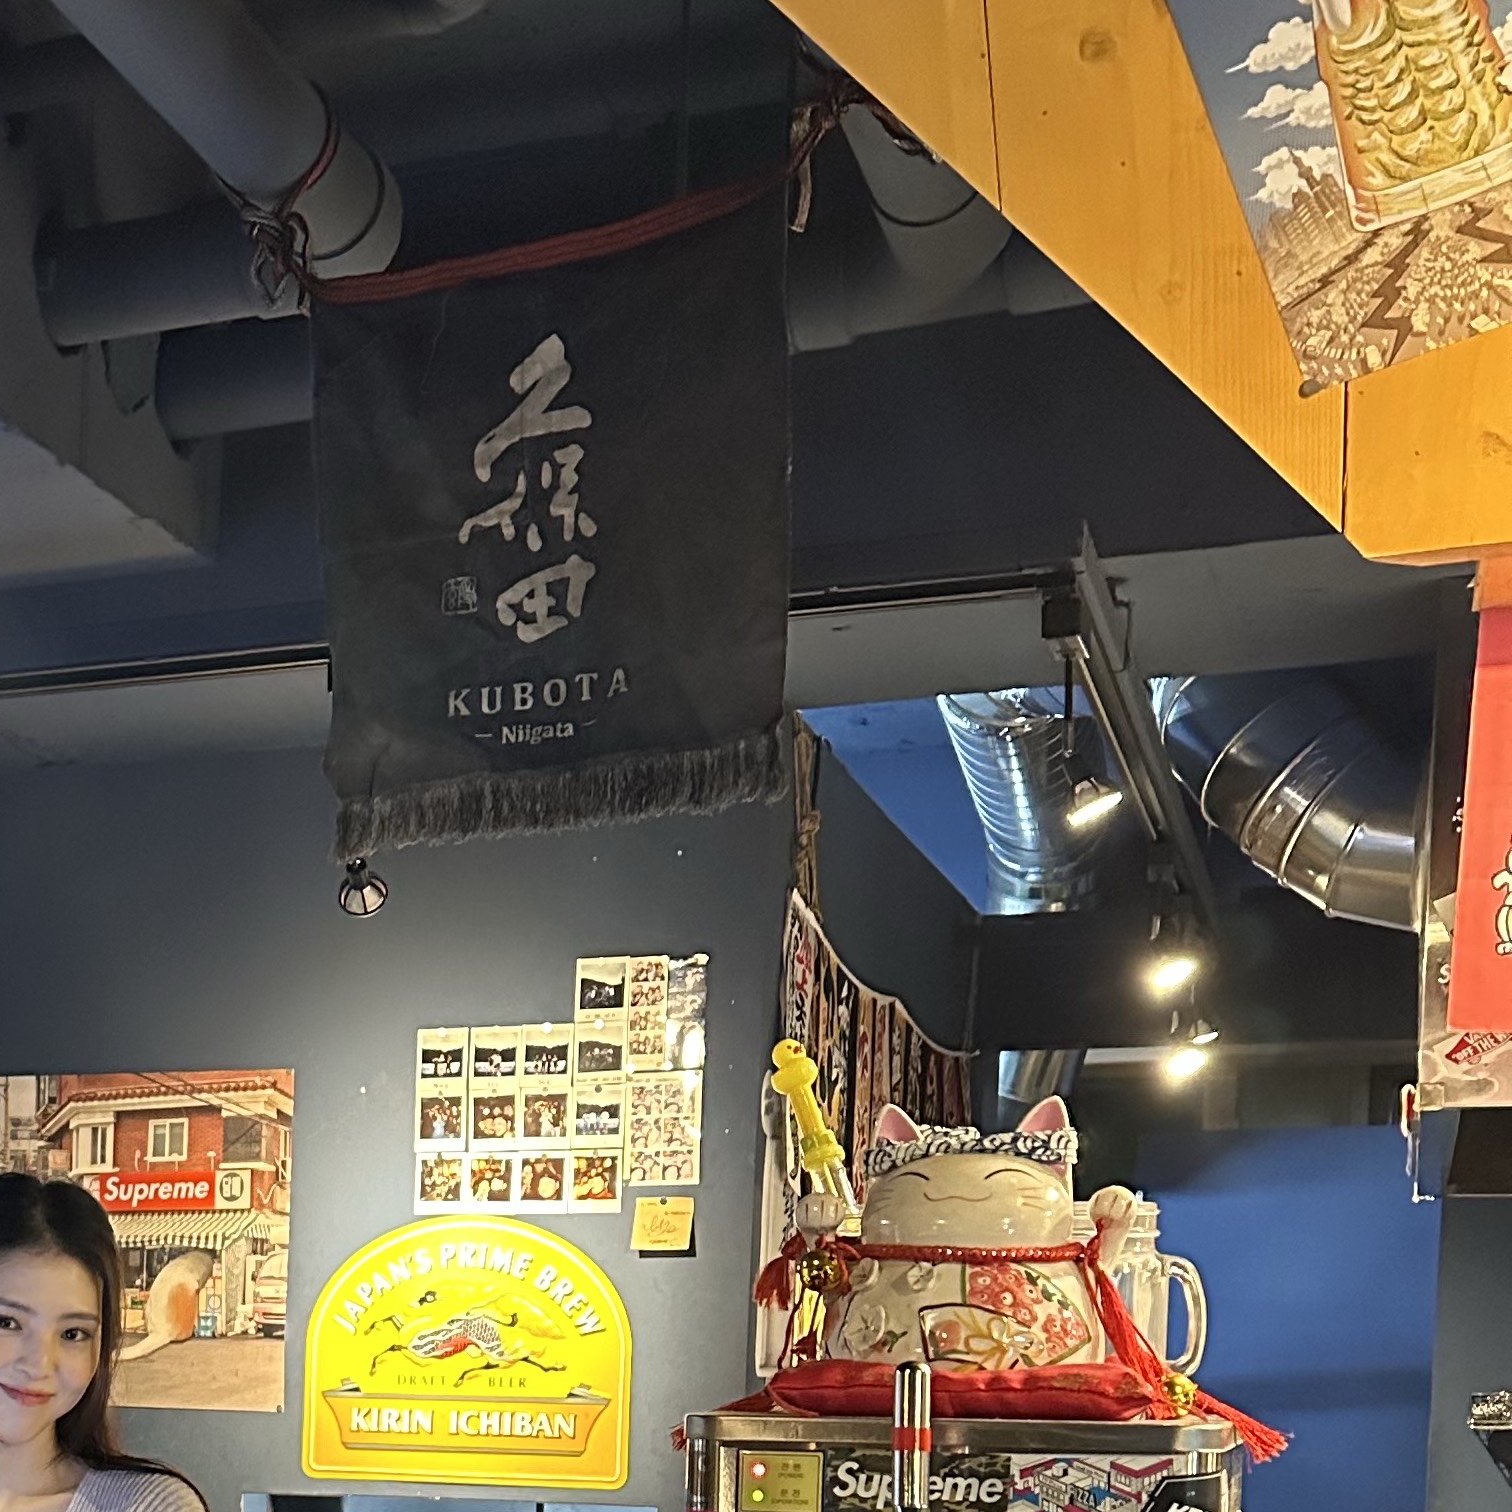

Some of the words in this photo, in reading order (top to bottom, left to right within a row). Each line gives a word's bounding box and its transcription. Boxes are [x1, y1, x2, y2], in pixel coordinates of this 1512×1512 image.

[447, 667, 629, 718] KUBOTA
[501, 721, 575, 745] Niigata
[102, 1176, 210, 1207] Supreme
[333, 1246, 434, 1336] JAPAN'S
[439, 1241, 535, 1281] PRIME
[533, 1262, 608, 1337] BREW
[350, 1406, 434, 1435] KIRIN
[447, 1409, 578, 1440] ICHIBAN
[833, 1461, 1003, 1509] Supeme
